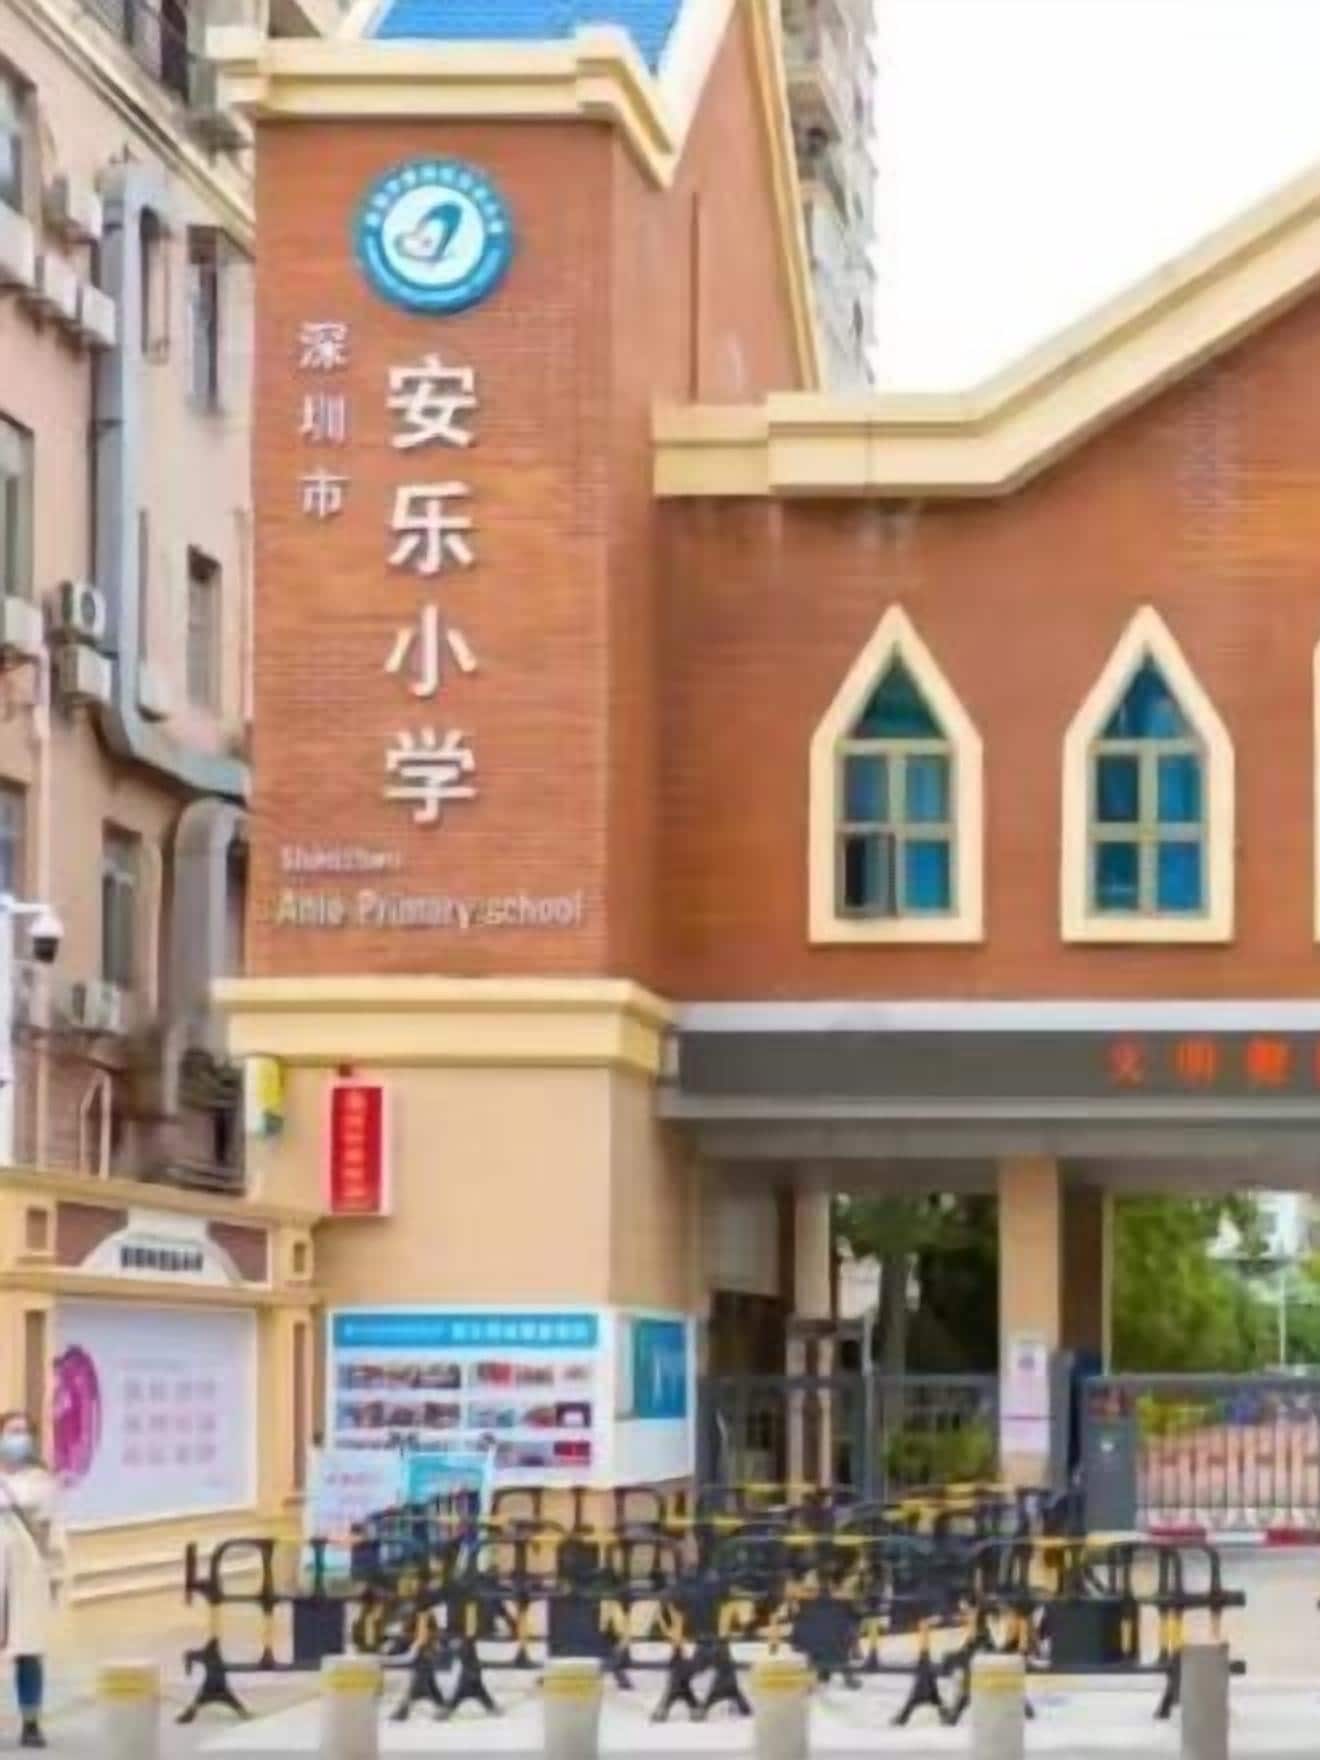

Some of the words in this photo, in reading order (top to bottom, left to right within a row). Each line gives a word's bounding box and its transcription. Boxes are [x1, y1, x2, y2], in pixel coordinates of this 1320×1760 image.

[299, 321, 349, 519] 深圳市
[385, 352, 479, 822] 安乐小学
[357, 888, 471, 929] Primary
